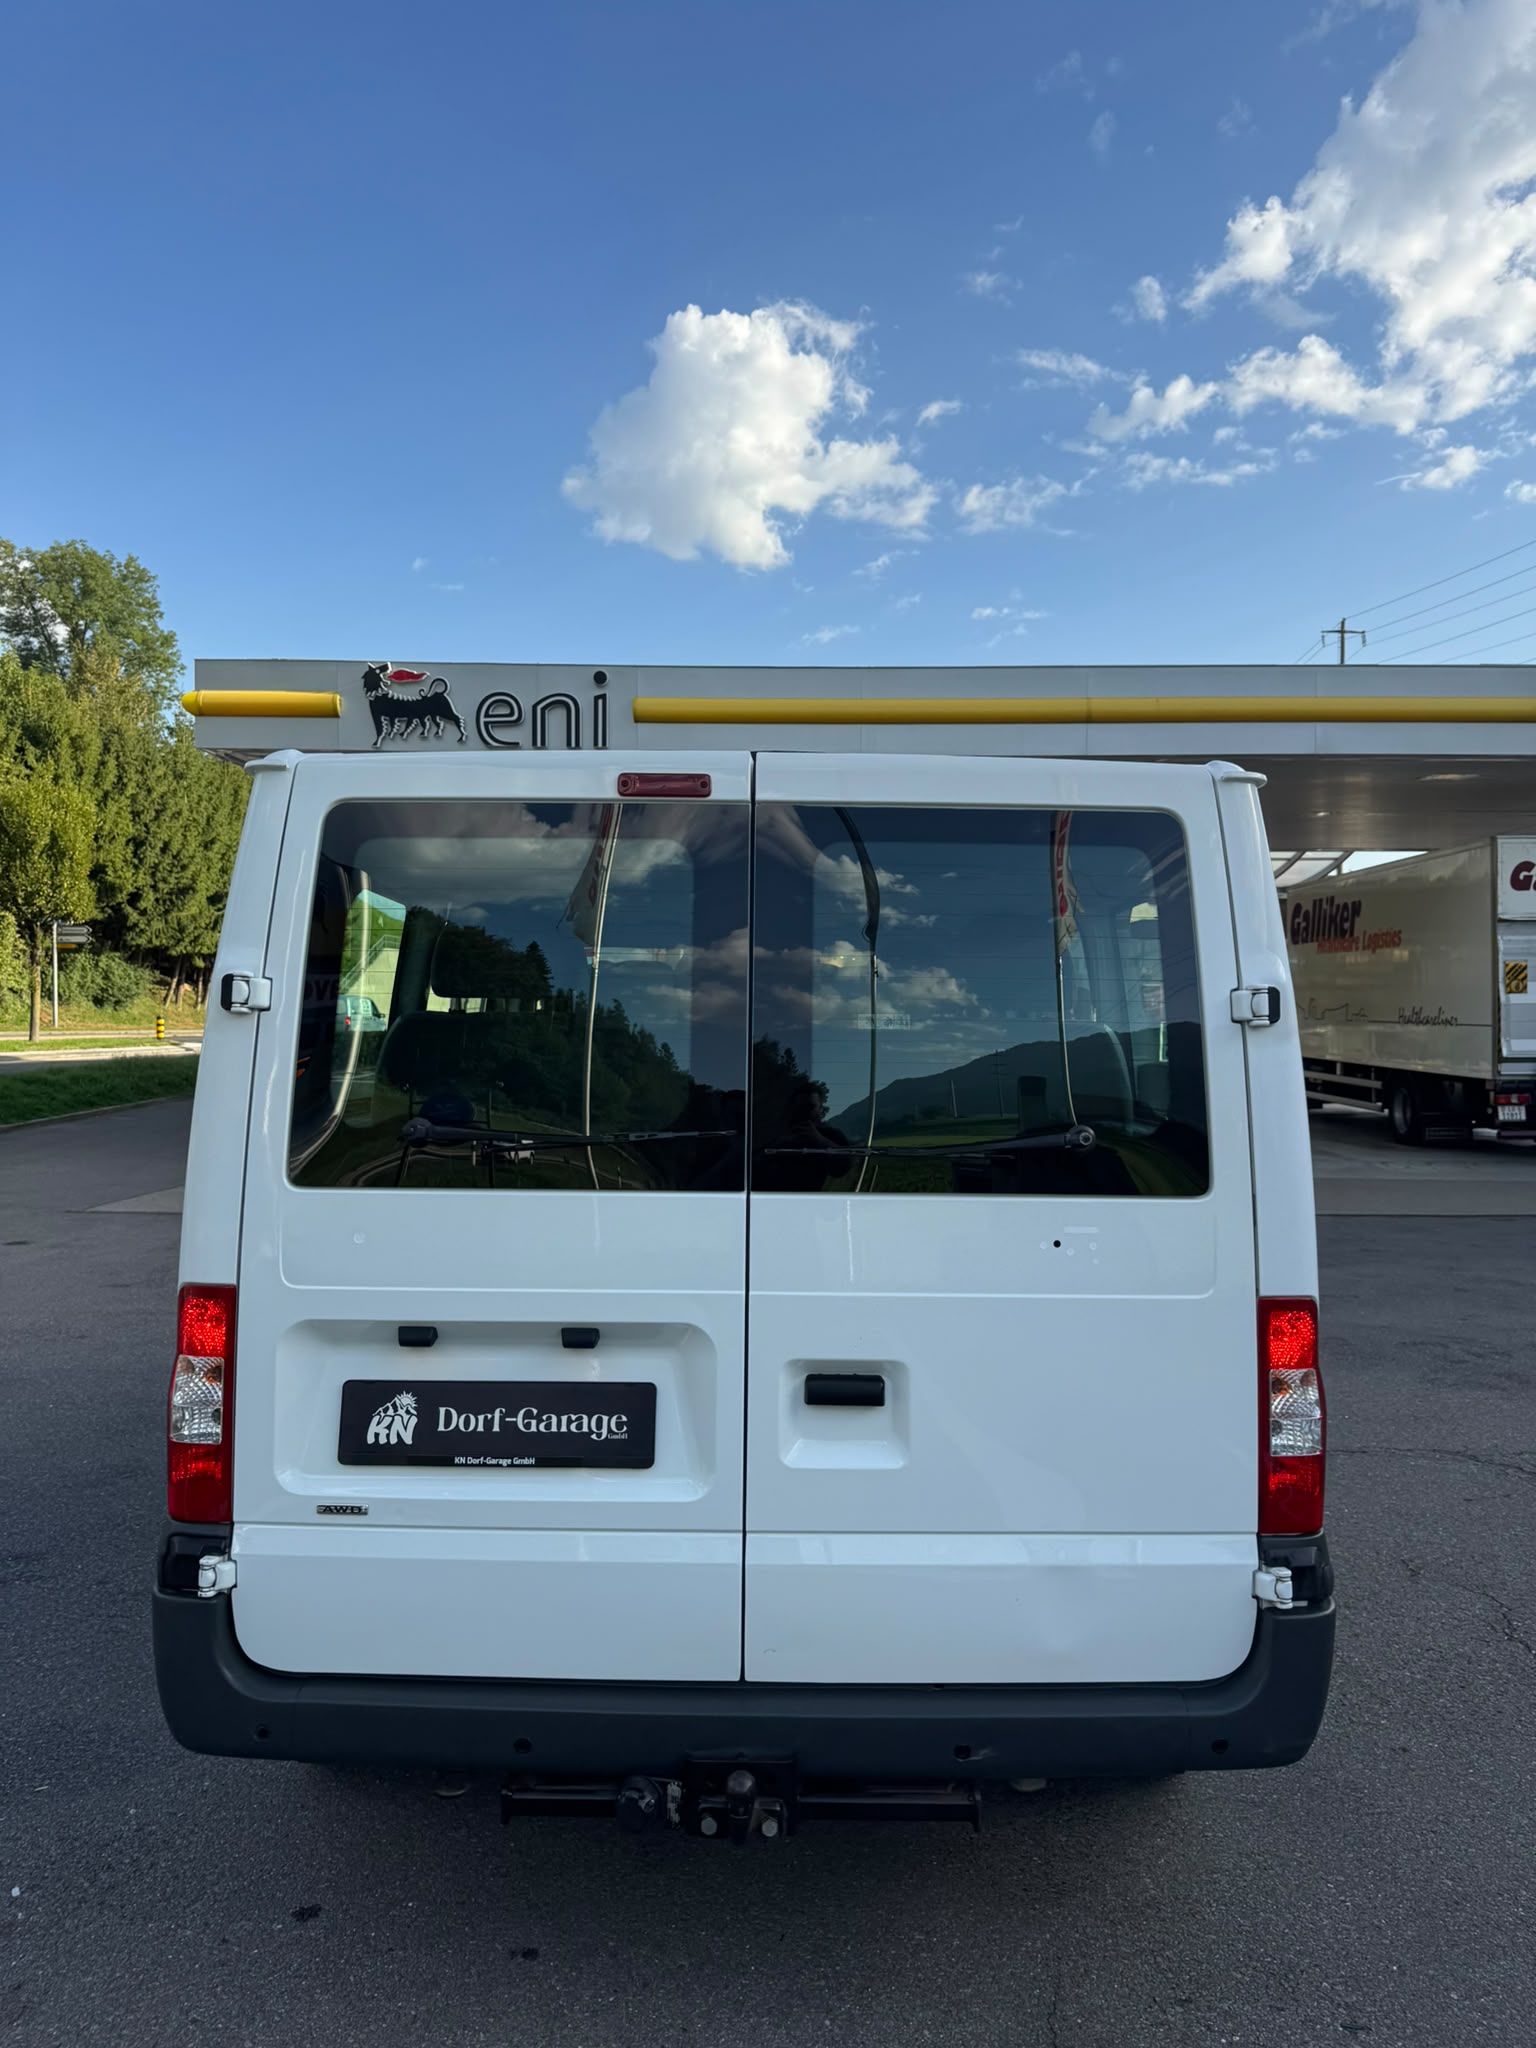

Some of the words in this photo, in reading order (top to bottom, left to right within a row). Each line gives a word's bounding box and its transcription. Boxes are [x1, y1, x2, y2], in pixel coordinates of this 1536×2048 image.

[475, 670, 608, 748] eni
[1510, 861, 1536, 891] G
[1291, 895, 1361, 945] Galliker
[367, 1414, 418, 1445] KN
[437, 1406, 628, 1441] Dorf-Garage
[607, 1432, 628, 1440] GmbH
[454, 1456, 466, 1465] KN
[467, 1456, 512, 1467] Dorf-Garage
[513, 1457, 536, 1466] GmbH
